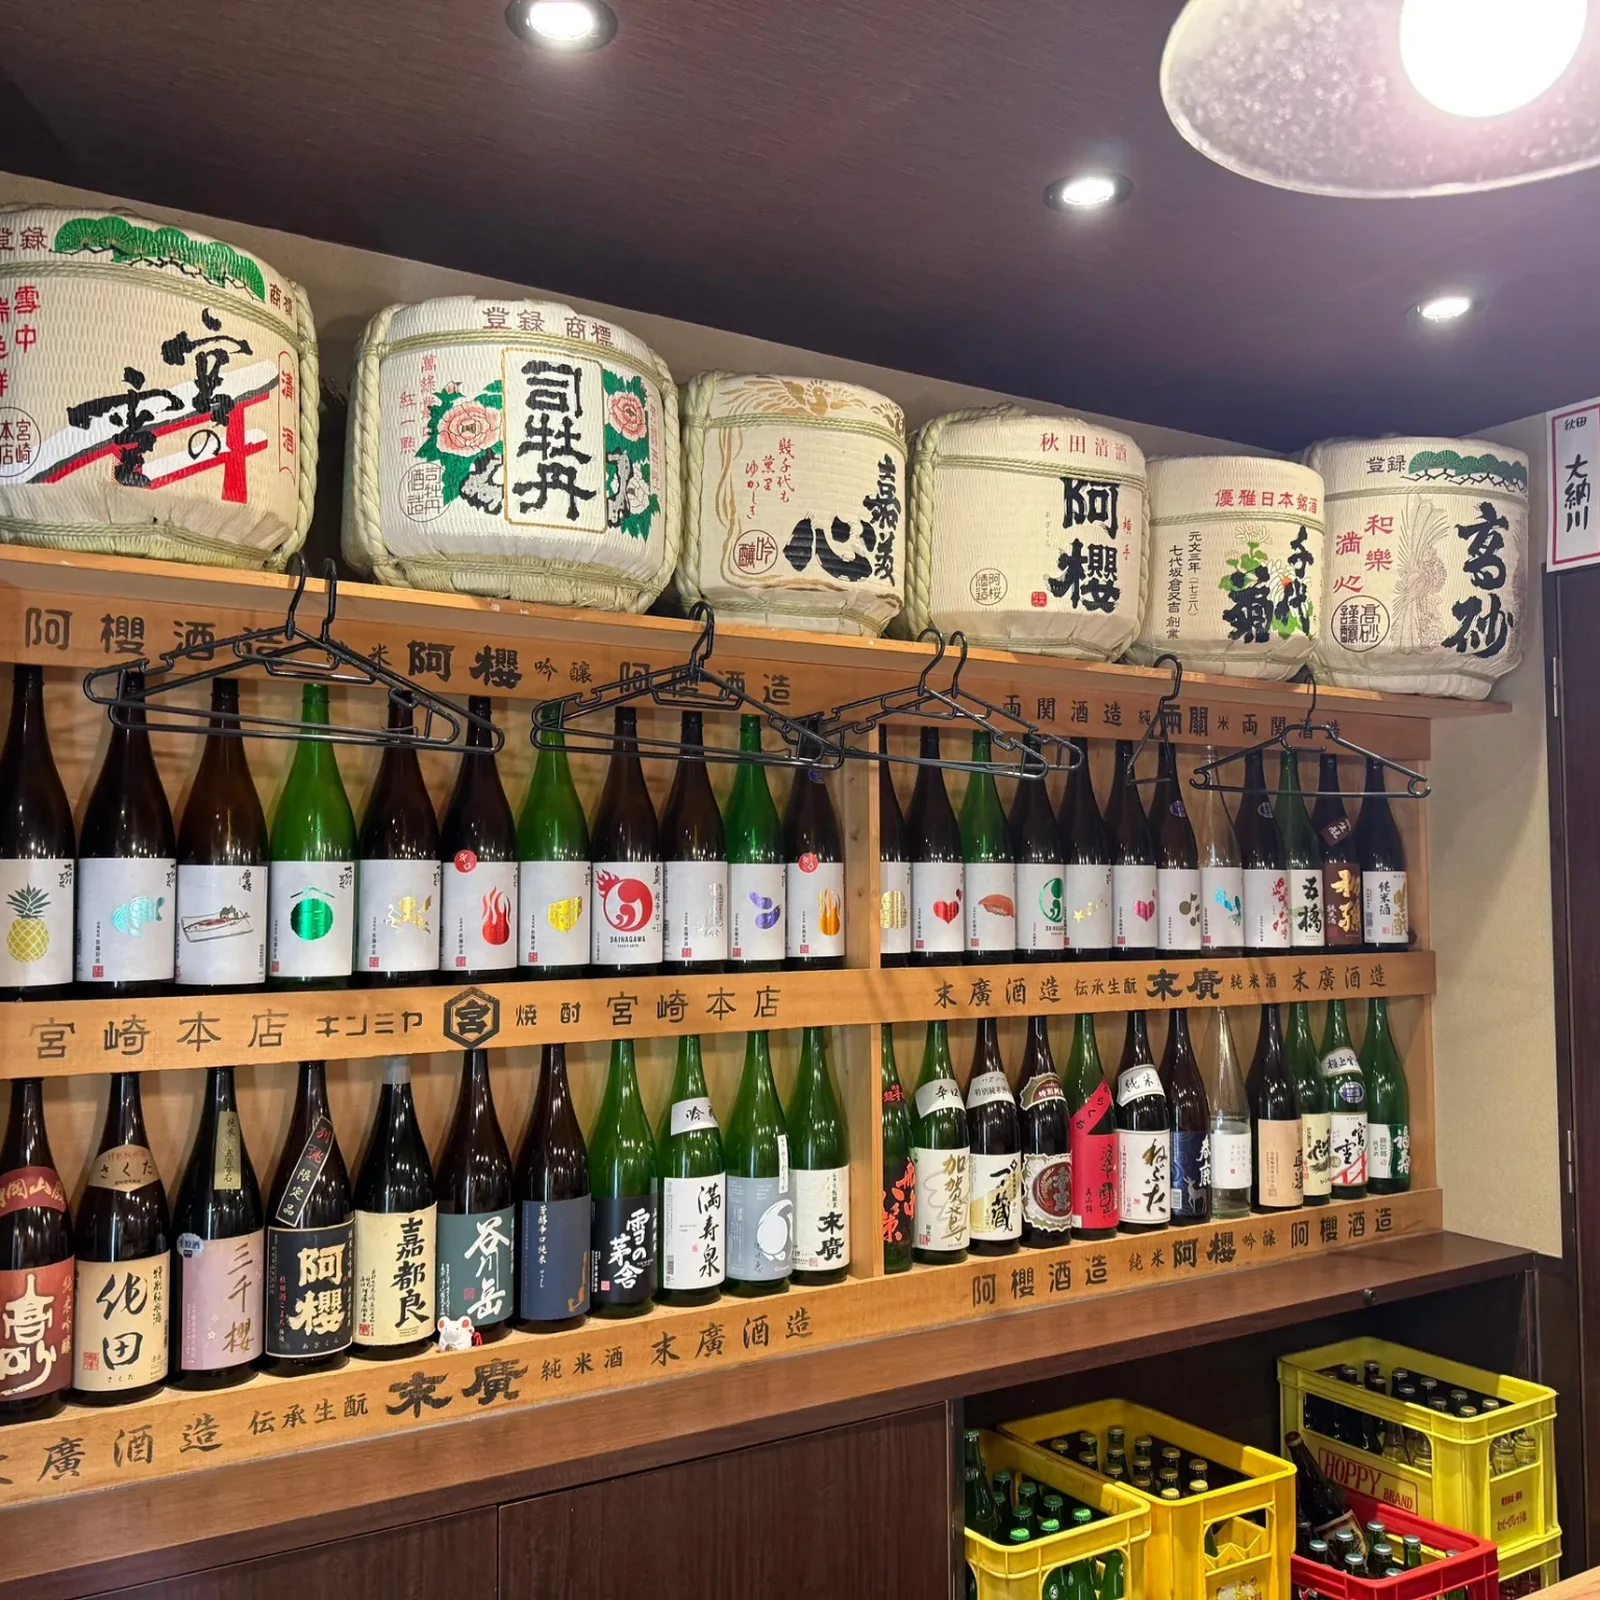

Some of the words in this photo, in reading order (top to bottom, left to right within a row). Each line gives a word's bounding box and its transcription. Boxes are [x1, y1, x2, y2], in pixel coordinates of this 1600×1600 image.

[0, 226, 48, 251] 登録
[14, 286, 41, 354] 雪中
[269, 283, 294, 320] 商標
[482, 306, 546, 332] 登録
[563, 316, 613, 346] 商標
[15, 419, 32, 465] 宮崎
[512, 359, 597, 521] 司牡丹
[1563, 416, 1587, 431] 秋田
[1040, 432, 1128, 463] 秋田清酒
[1366, 454, 1407, 475] 登録
[1215, 488, 1318, 514] 優雅日本銘酒
[1564, 454, 1591, 533] 大納川
[1042, 476, 1121, 613] 阿櫻
[1122, 517, 1133, 561] 横手
[406, 640, 523, 690] 阿櫻
[1002, 693, 1123, 727] 両関酒造
[1217, 715, 1230, 731] 米
[458, 852, 472, 871] 辛口
[801, 854, 815, 870] 辛口
[1298, 876, 1323, 934] 五橋
[1379, 881, 1391, 916] 純米酒
[609, 935, 646, 943] DAINAGAWA
[934, 974, 1062, 1009] 末廣酒造
[1074, 971, 1138, 996] 伝承生酛
[1145, 967, 1224, 1001] 末廣
[1230, 971, 1277, 991] 純米酒
[1291, 966, 1389, 991] 末廣酒造
[28, 1008, 289, 1060] 宮崎本店
[315, 1010, 423, 1038] キンミヤ
[515, 1001, 581, 1026] 焼酎
[606, 984, 781, 1026] 宮崎本店
[935, 1085, 960, 1100] 辛口
[100, 1159, 154, 1180] さくた
[223, 1149, 235, 1182] 五百万石
[1141, 1138, 1168, 1213] ねぶた
[282, 1168, 312, 1217] 限定品
[697, 1182, 722, 1279] 満寿泉
[816, 1211, 845, 1261] 末廣
[390, 1216, 430, 1328] 嘉都良
[464, 1215, 510, 1320] 谷川岳
[972, 1255, 1109, 1309] 阿櫻酒造
[1127, 1249, 1166, 1272] 純米
[1172, 1232, 1237, 1269] 阿櫻
[1290, 1207, 1392, 1249] 阿櫻酒造
[152, 1266, 163, 1326] 特別純米酒
[222, 1242, 254, 1353] 三千櫻
[287, 1242, 347, 1336] 阿櫻
[62, 1275, 73, 1354] 純米吟醸
[107, 1373, 134, 1384] さくた
[248, 1393, 369, 1436] 伝承生酛
[386, 1357, 529, 1419] 末廣
[540, 1347, 623, 1381] 純米酒
[650, 1306, 815, 1367] 末廣酒造
[1324, 1453, 1382, 1497] HOPPY
[1383, 1487, 1413, 1511] BRAND
